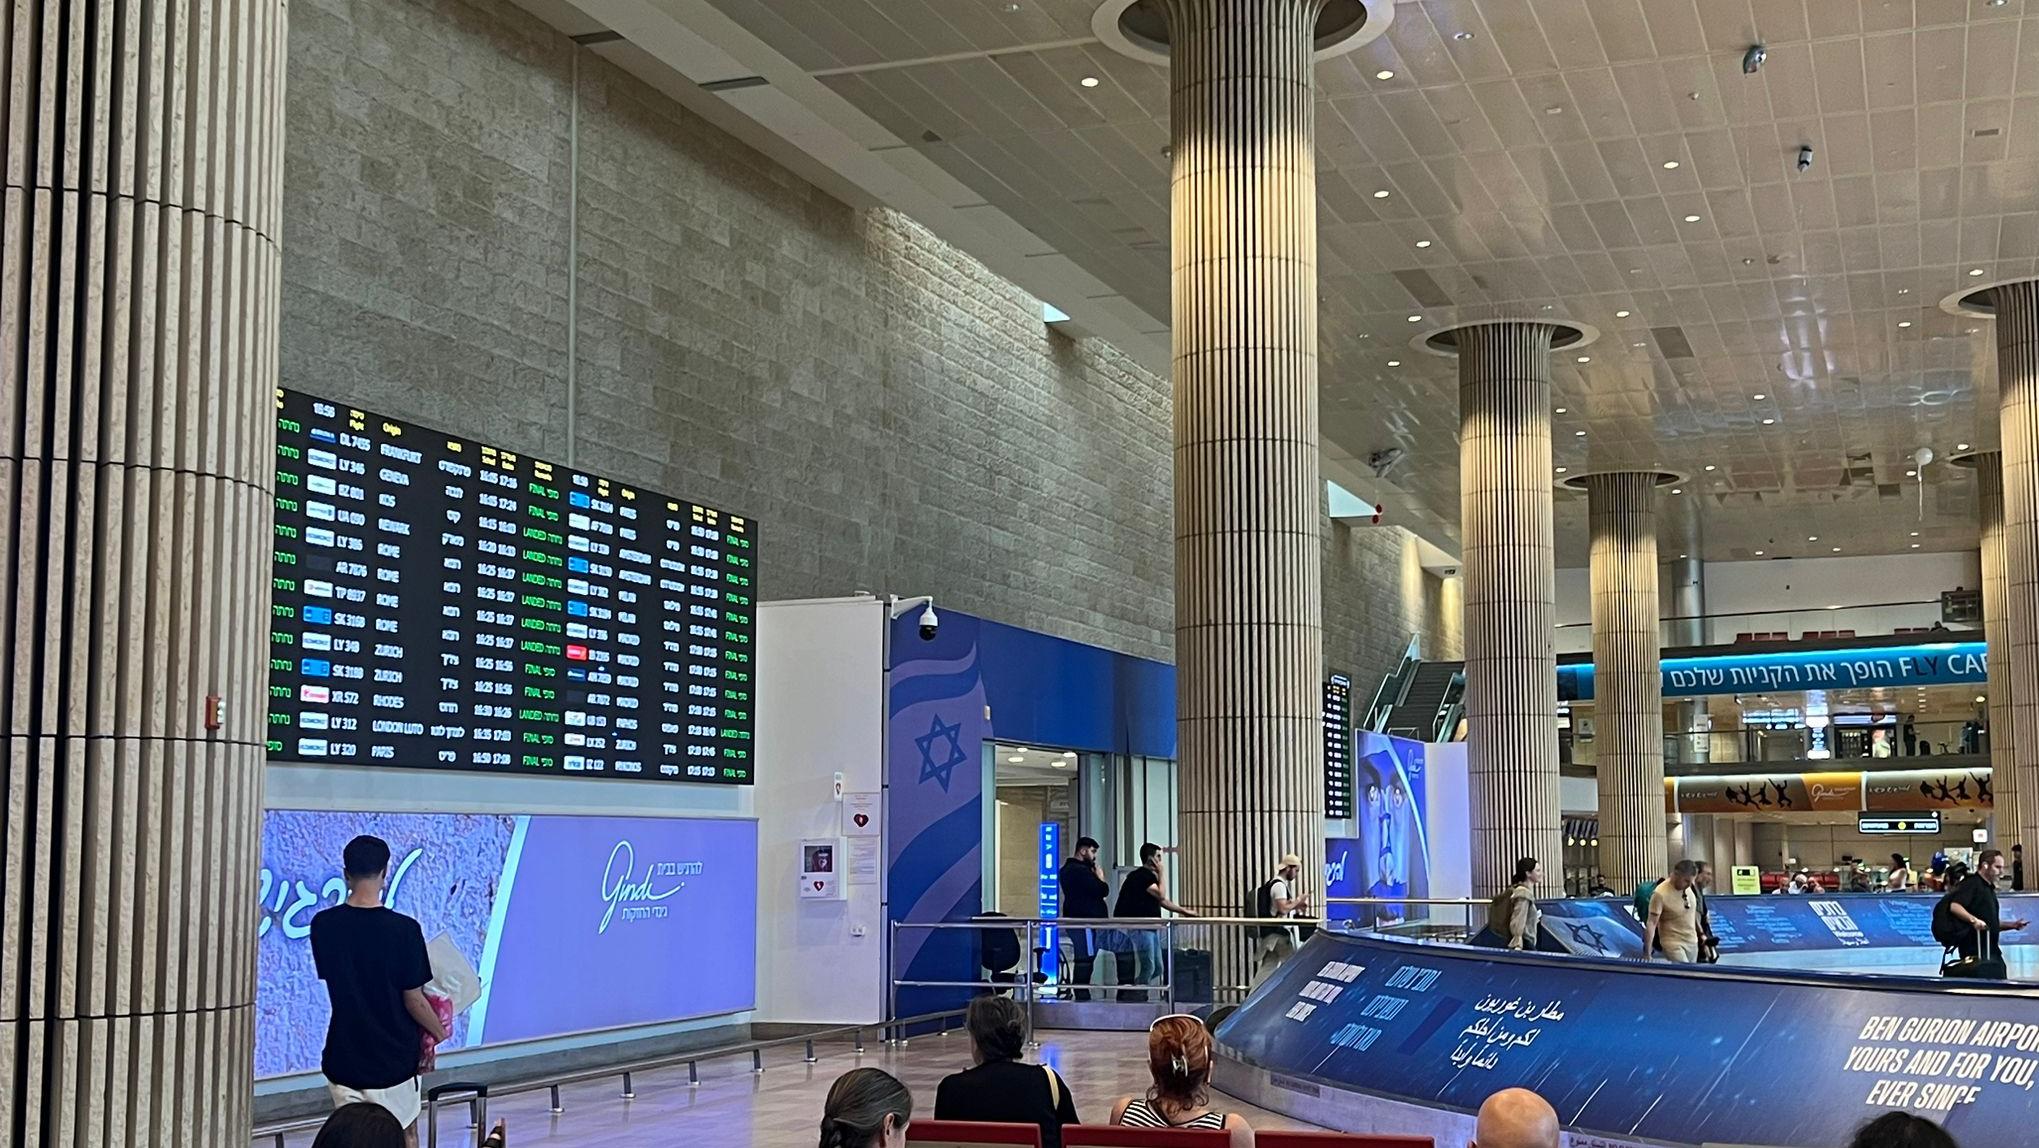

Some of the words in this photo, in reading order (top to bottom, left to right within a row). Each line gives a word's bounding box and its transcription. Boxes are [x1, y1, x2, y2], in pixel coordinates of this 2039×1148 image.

[529, 483, 545, 496] FINAL
[529, 506, 545, 518] FINAL
[524, 528, 546, 540] LANDED
[523, 551, 546, 563] LANDED
[523, 573, 545, 585] LANDED
[522, 596, 545, 607] LANDED
[334, 613, 346, 625] SK
[521, 641, 544, 652] LANDED
[522, 619, 544, 630] LANDED
[334, 639, 345, 650] LY
[525, 664, 541, 675] FINAL
[1899, 656, 1938, 677] FLY
[333, 665, 344, 677] SK
[525, 687, 540, 697] FINAL
[1670, 666, 1724, 688] שלכם
[1730, 665, 1800, 688] הקניות
[1804, 663, 1837, 682] את
[1840, 660, 1893, 685] הופך
[344, 692, 358, 704] 572
[373, 694, 404, 708] RHODES
[520, 710, 542, 720] LANDED
[331, 717, 342, 729] LY
[342, 718, 357, 730] 312
[373, 720, 404, 733] LONDON
[524, 733, 540, 743] FINAL
[330, 743, 341, 755] LY
[523, 756, 539, 766] FINAL
[1474, 993, 1521, 1014] غوريون
[1514, 1001, 1535, 1018] بن
[1529, 1000, 1564, 1021] مطار
[1506, 1028, 1541, 1051] لكم
[1858, 1016, 1904, 1041] BEN
[1898, 1017, 1977, 1045] GURION
[1843, 1046, 1909, 1074] YOURS
[1903, 1049, 1950, 1076] AND
[1946, 1052, 1992, 1080] FOR
[1990, 1054, 2038, 1091] YOU,
[1866, 1080, 1918, 1107] EVER
